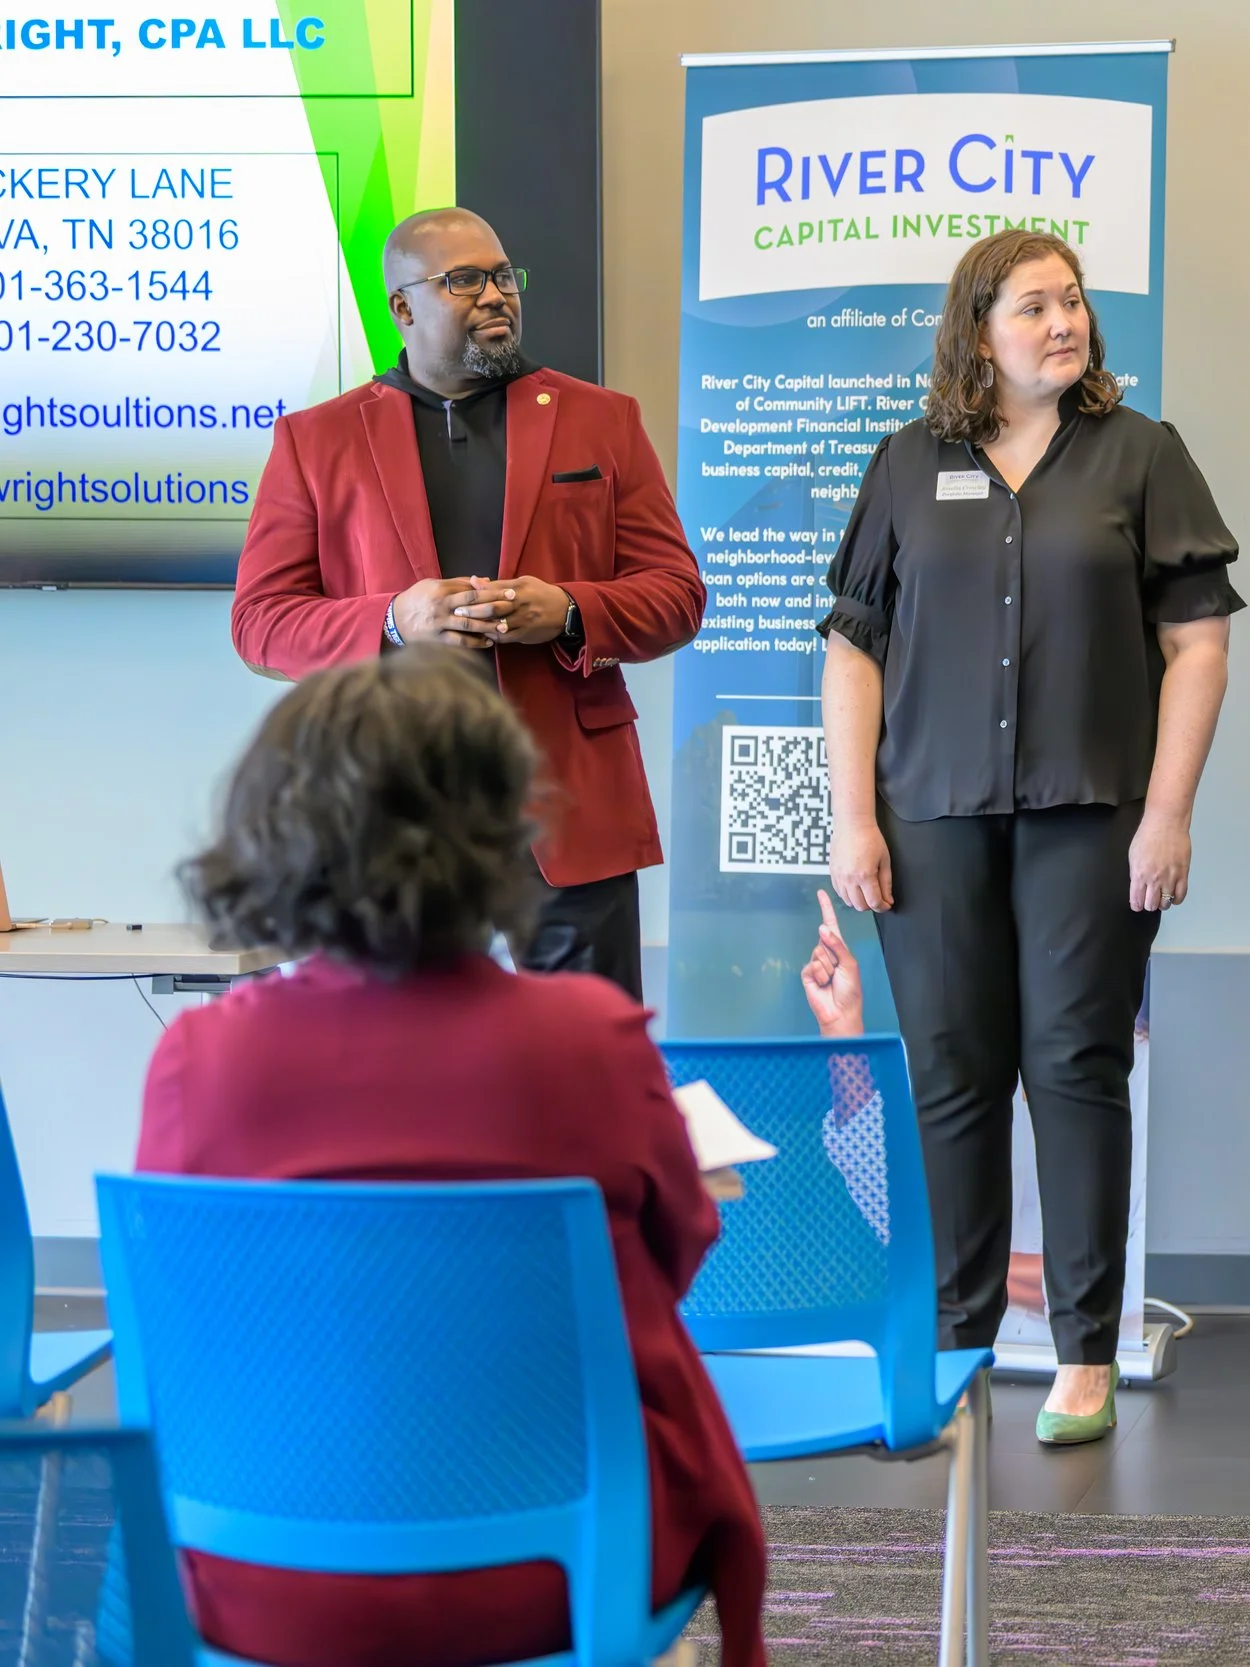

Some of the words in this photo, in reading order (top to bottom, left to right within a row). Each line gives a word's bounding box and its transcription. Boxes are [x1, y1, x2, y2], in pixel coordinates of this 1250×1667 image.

[0, 18, 121, 57] IGHT,
[138, 18, 226, 49] CPA
[243, 17, 325, 50] LLC
[0, 168, 116, 199] KERY
[131, 168, 233, 199] LANE
[62, 219, 113, 250] TN
[128, 219, 239, 250] 38016
[754, 215, 879, 250] CAPITAL
[892, 213, 1090, 245] INVESTMENT
[0, 270, 213, 301] 1-363-1544
[807, 313, 826, 328] an
[830, 308, 886, 328] affiliate
[891, 308, 907, 327] of
[701, 375, 739, 390] River
[742, 375, 771, 392] City
[775, 374, 824, 392] Capital
[828, 373, 893, 389] launched
[896, 373, 911, 389] in
[736, 397, 750, 412] of
[753, 396, 833, 413] Community
[836, 395, 872, 411] LIFT.
[876, 395, 914, 411] River
[700, 418, 792, 436] Development
[797, 418, 861, 433] Financial
[723, 440, 807, 457] Department
[811, 440, 825, 454] of
[702, 462, 760, 477] business
[764, 462, 814, 480] capital,
[818, 462, 862, 478] credit,
[700, 527, 725, 542] We
[729, 527, 759, 542] lead
[762, 527, 785, 542] the
[789, 531, 818, 545] way
[822, 527, 836, 542] in
[703, 570, 732, 586] loan
[736, 571, 787, 588] options
[790, 574, 815, 586] are
[716, 592, 747, 607] both
[751, 595, 781, 607] now
[784, 593, 812, 608] and
[701, 614, 754, 632] existing
[693, 636, 770, 654] application
[774, 636, 817, 655] today!
